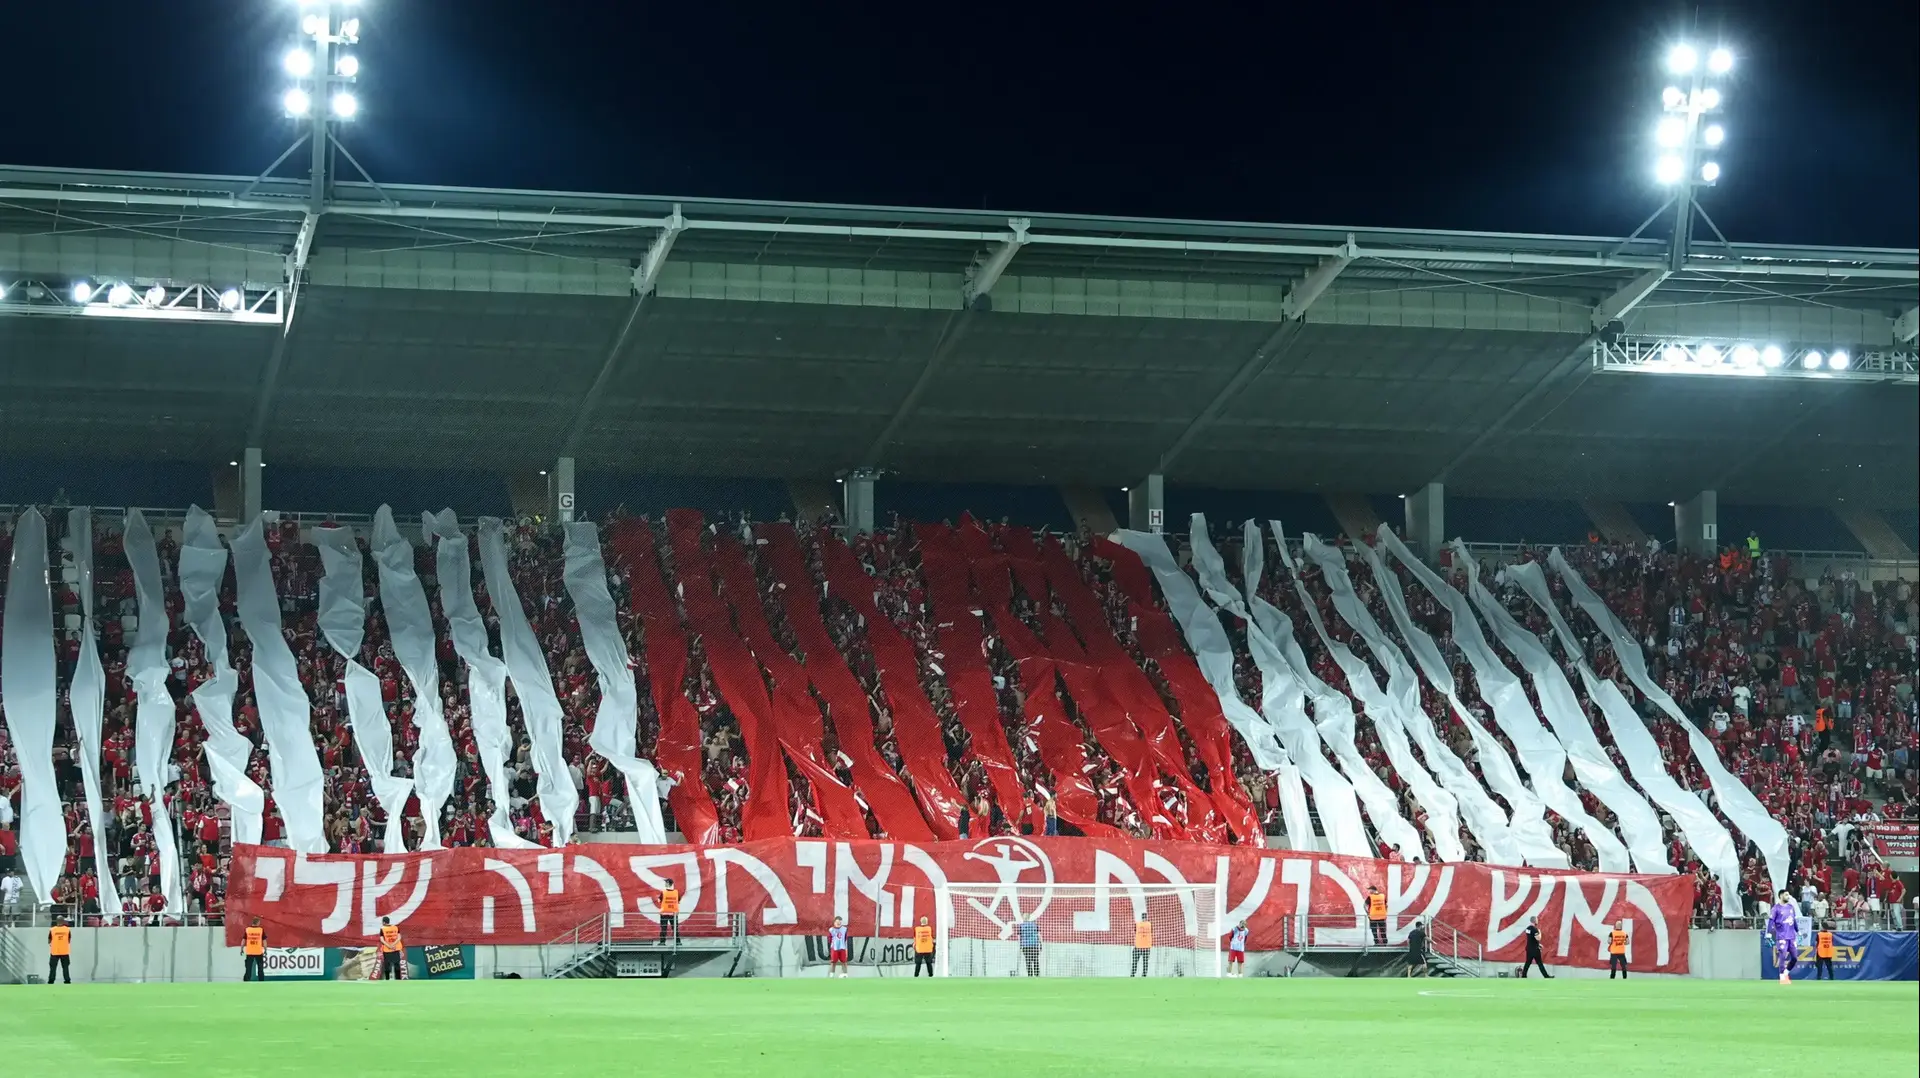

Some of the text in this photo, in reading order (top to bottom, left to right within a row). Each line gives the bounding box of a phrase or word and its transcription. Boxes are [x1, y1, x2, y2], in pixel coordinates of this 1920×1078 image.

[560, 494, 573, 508] G
[1151, 510, 1162, 524] H
[254, 841, 1670, 967] האש שבוערת האימפריה שלי
[426, 947, 460, 963] habos
[881, 943, 914, 963] MAC
[262, 954, 320, 969] BORSODI
[430, 958, 463, 974] oldala
